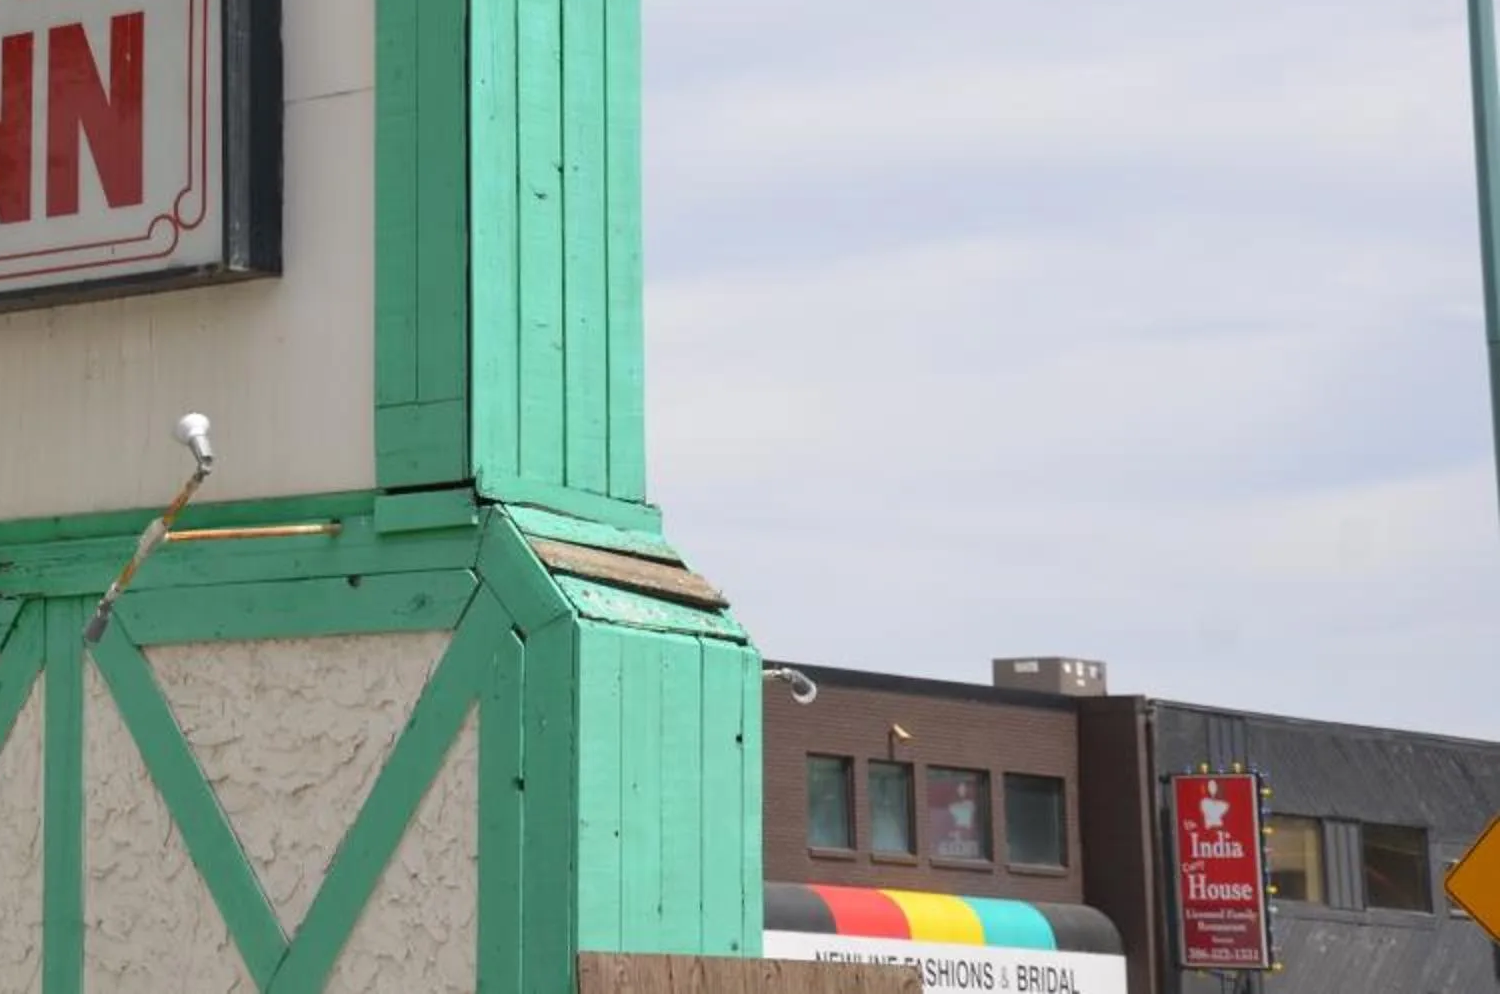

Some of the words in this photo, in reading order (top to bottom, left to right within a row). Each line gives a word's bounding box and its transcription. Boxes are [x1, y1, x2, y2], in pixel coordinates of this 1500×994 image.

[1190, 830, 1244, 859] India
[1188, 874, 1253, 901] House
[1017, 964, 1080, 994] BRIDAL
